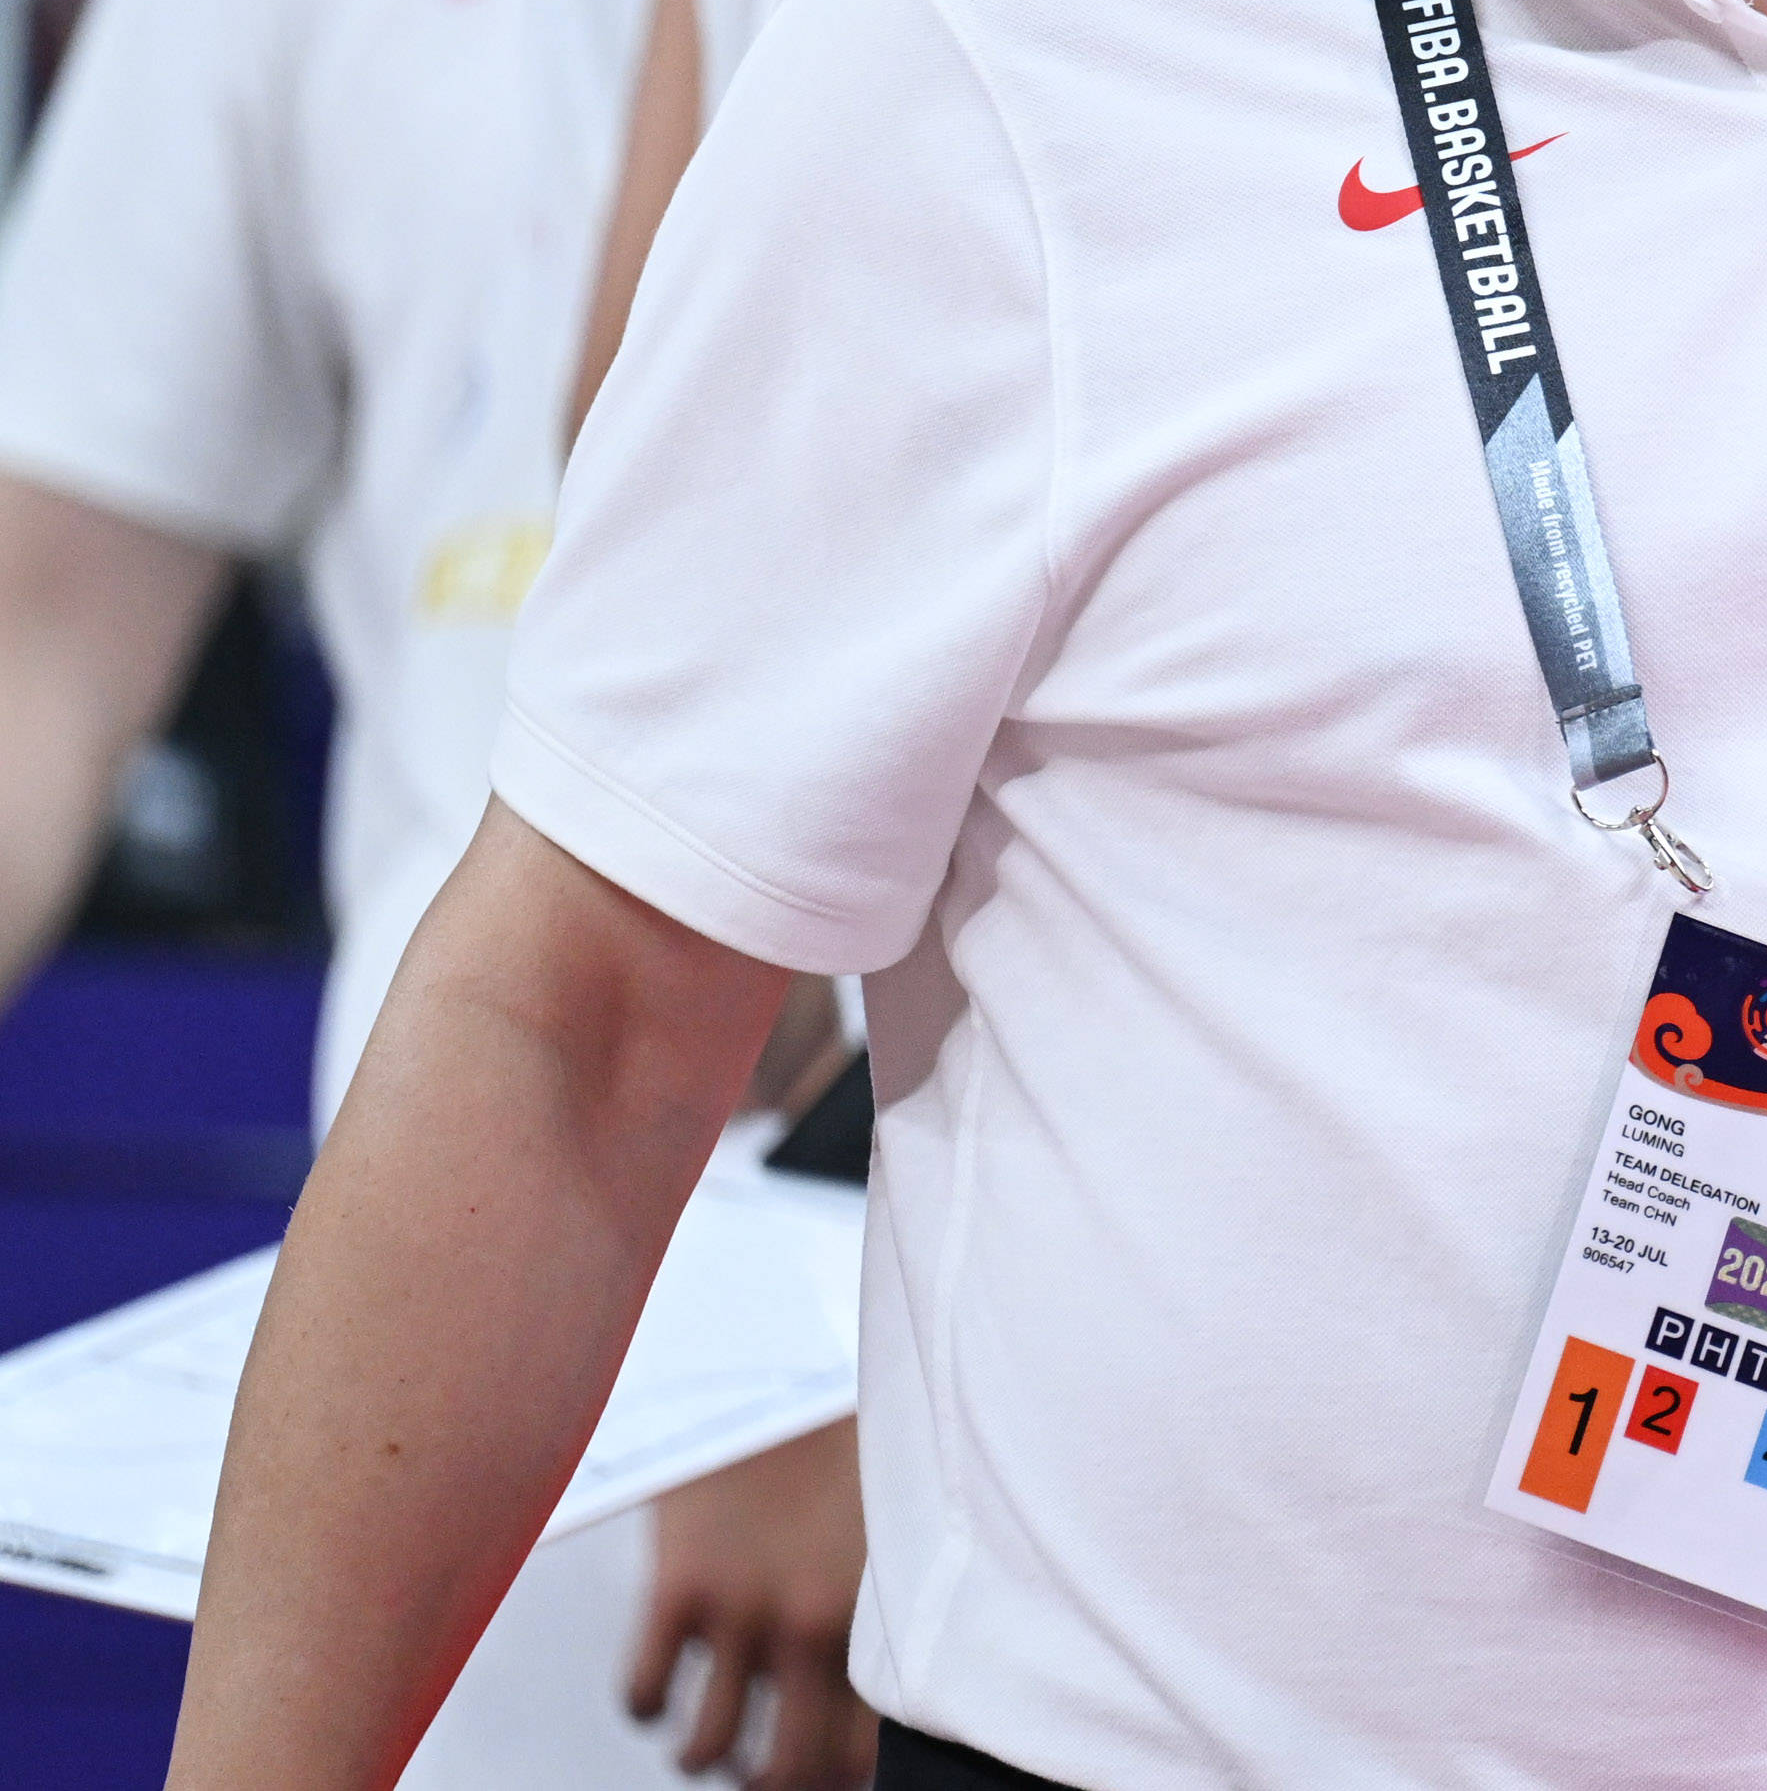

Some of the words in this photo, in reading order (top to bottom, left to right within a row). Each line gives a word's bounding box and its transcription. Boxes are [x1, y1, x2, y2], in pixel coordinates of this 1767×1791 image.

[1529, 460, 1557, 507] Made
[1541, 512, 1567, 557] from
[1554, 558, 1589, 637] recycled
[1572, 638, 1599, 673] PET
[1621, 1124, 1685, 1157] LUMING
[1629, 1104, 1685, 1136] GONG
[1607, 1170, 1644, 1193] Head
[1647, 1186, 1690, 1211] Coach
[1615, 1151, 1658, 1177] TEAM
[1660, 1168, 1760, 1215] DELEGATION
[1603, 1189, 1640, 1213] Team
[1644, 1205, 1677, 1227] CHN
[1582, 1246, 1635, 1274] 906547
[1592, 1227, 1635, 1253] 13-20
[1638, 1243, 1669, 1266] JUL
[1655, 1316, 1686, 1347] P
[1699, 1332, 1730, 1369] H
[1568, 1387, 1599, 1456] 1
[1641, 1385, 1682, 1436] 2
